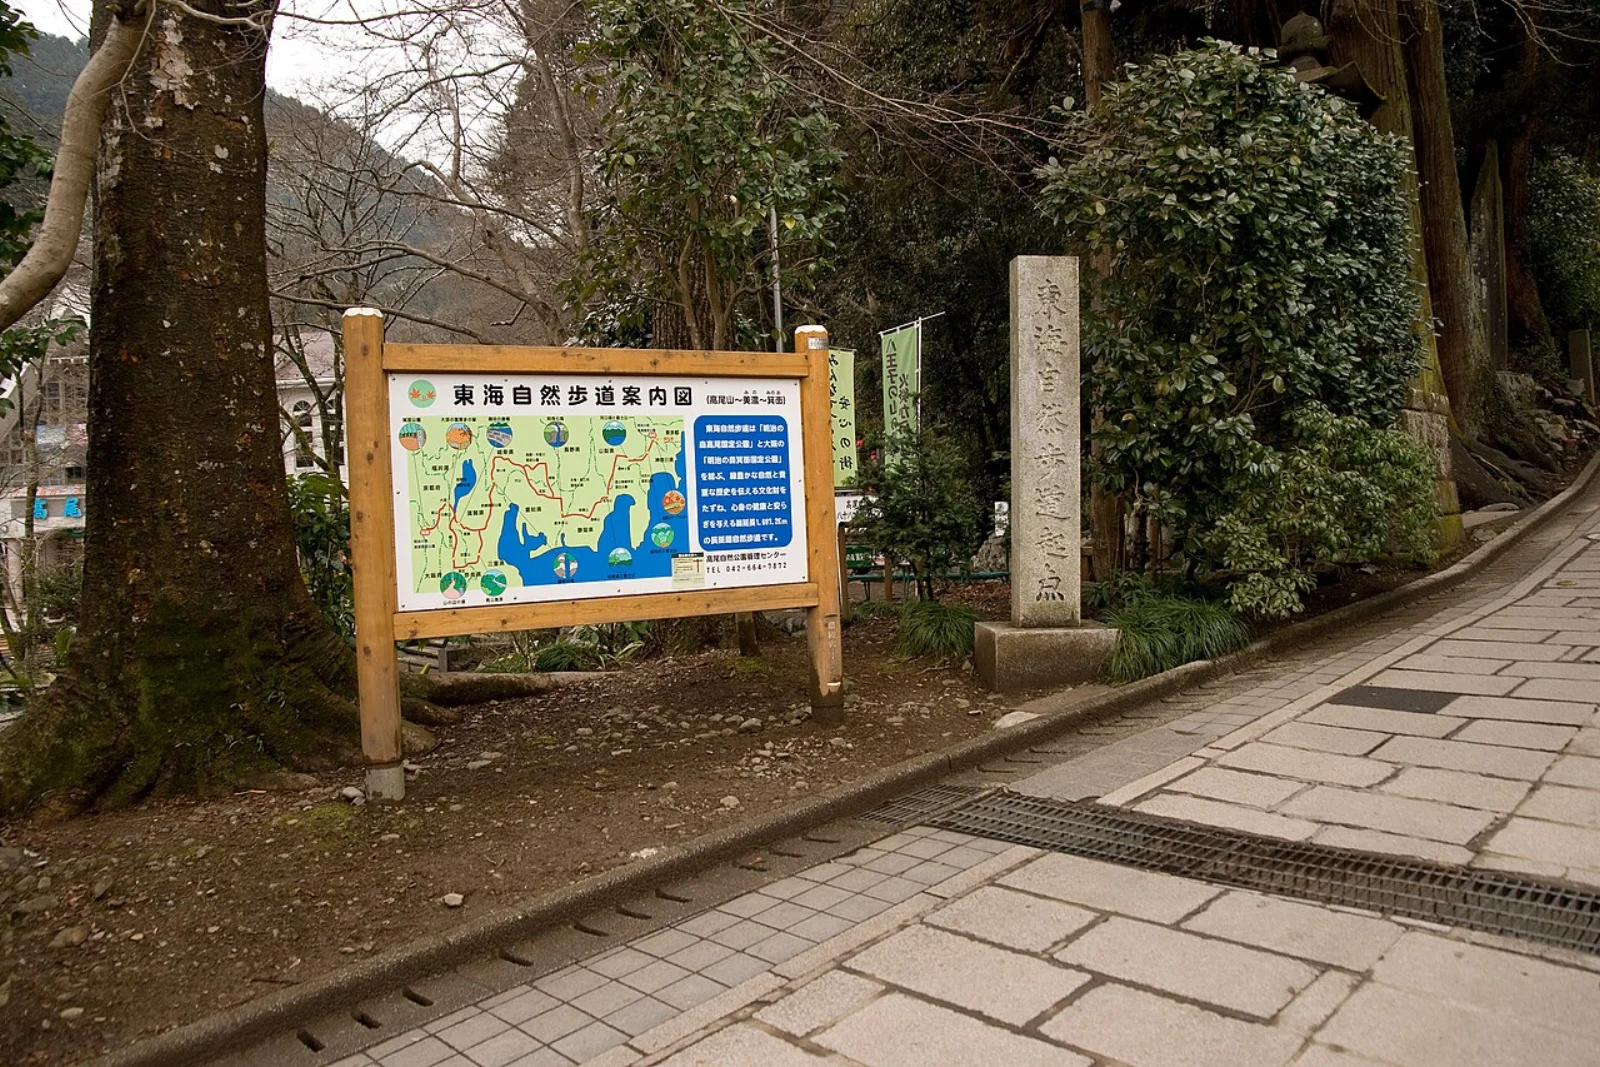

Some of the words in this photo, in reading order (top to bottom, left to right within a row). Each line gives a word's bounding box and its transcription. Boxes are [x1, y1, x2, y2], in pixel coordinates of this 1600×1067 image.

[453, 384, 692, 406] 東海自然歩道案内図
